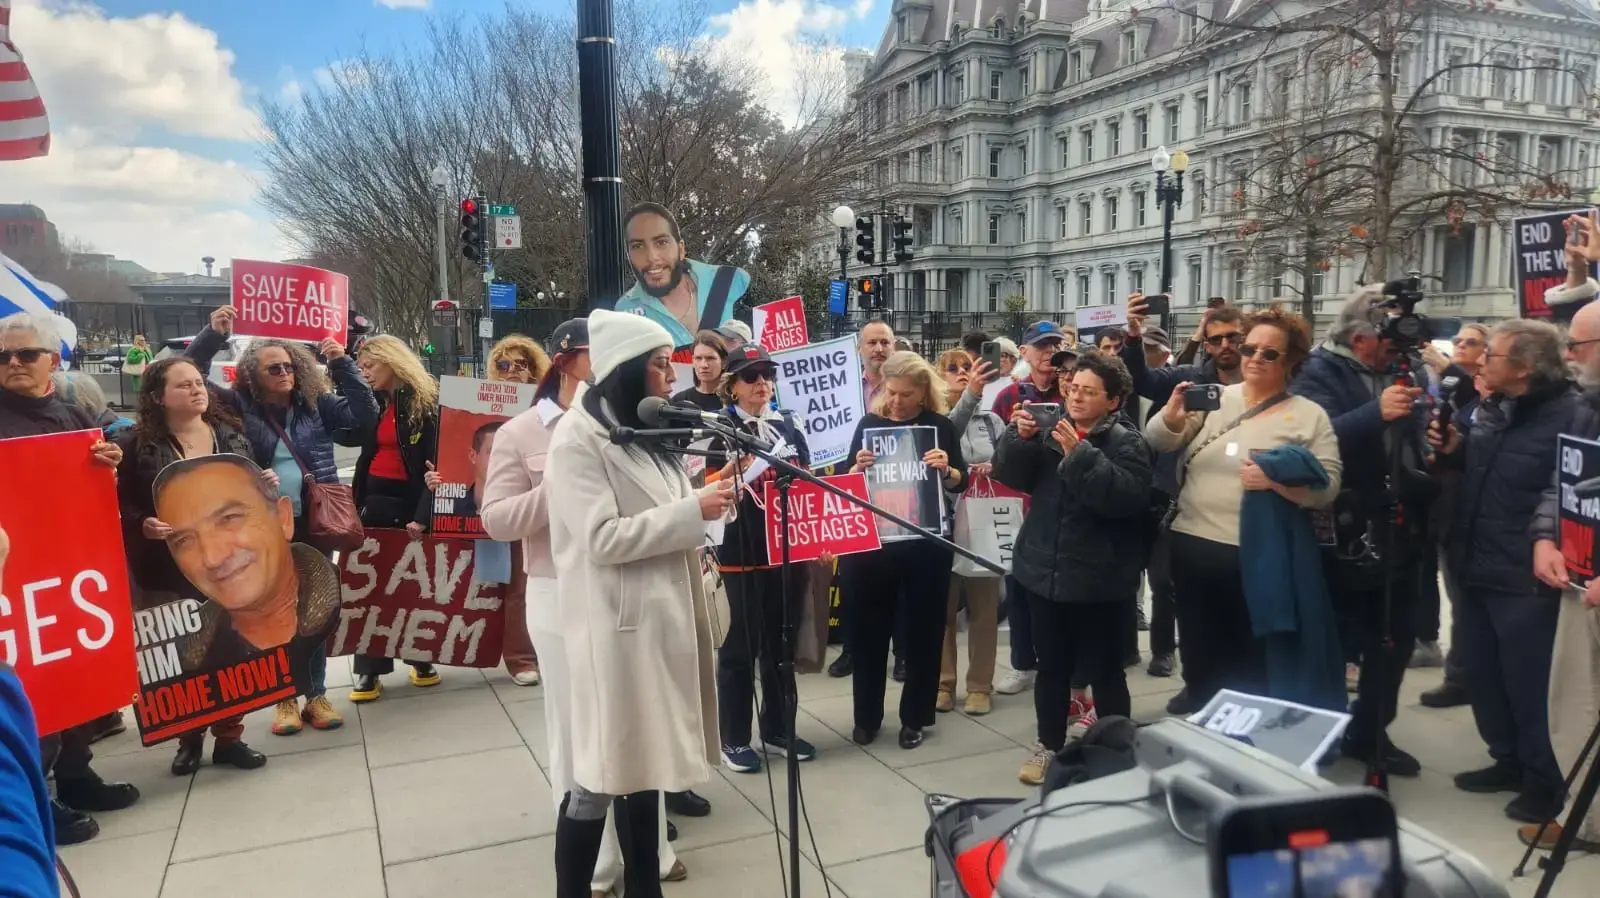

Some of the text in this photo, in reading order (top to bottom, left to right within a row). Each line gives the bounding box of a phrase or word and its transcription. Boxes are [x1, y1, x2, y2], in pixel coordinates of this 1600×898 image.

[1521, 222, 1551, 245] END
[1522, 250, 1553, 273] THE
[242, 273, 342, 309] SAVE ALL
[242, 299, 342, 333] HOSTAGES
[775, 308, 801, 329] ALL
[783, 350, 847, 378] BRING
[790, 369, 847, 396] THEM
[807, 393, 840, 414] ALL
[872, 435, 897, 457] END
[875, 461, 928, 484] THE WAR
[435, 483, 467, 498] BRING
[434, 499, 454, 514] HIM
[773, 492, 819, 521] SAVE
[823, 488, 864, 517] ALL
[1581, 498, 1600, 521] WA
[433, 516, 462, 532] HOME
[774, 514, 869, 548] HOSTAGES
[993, 506, 1013, 563] TATTE
[341, 536, 503, 612] SAVE
[331, 604, 487, 664] THEM
[137, 647, 293, 727] HOME NOW!
[1204, 702, 1262, 736] END
